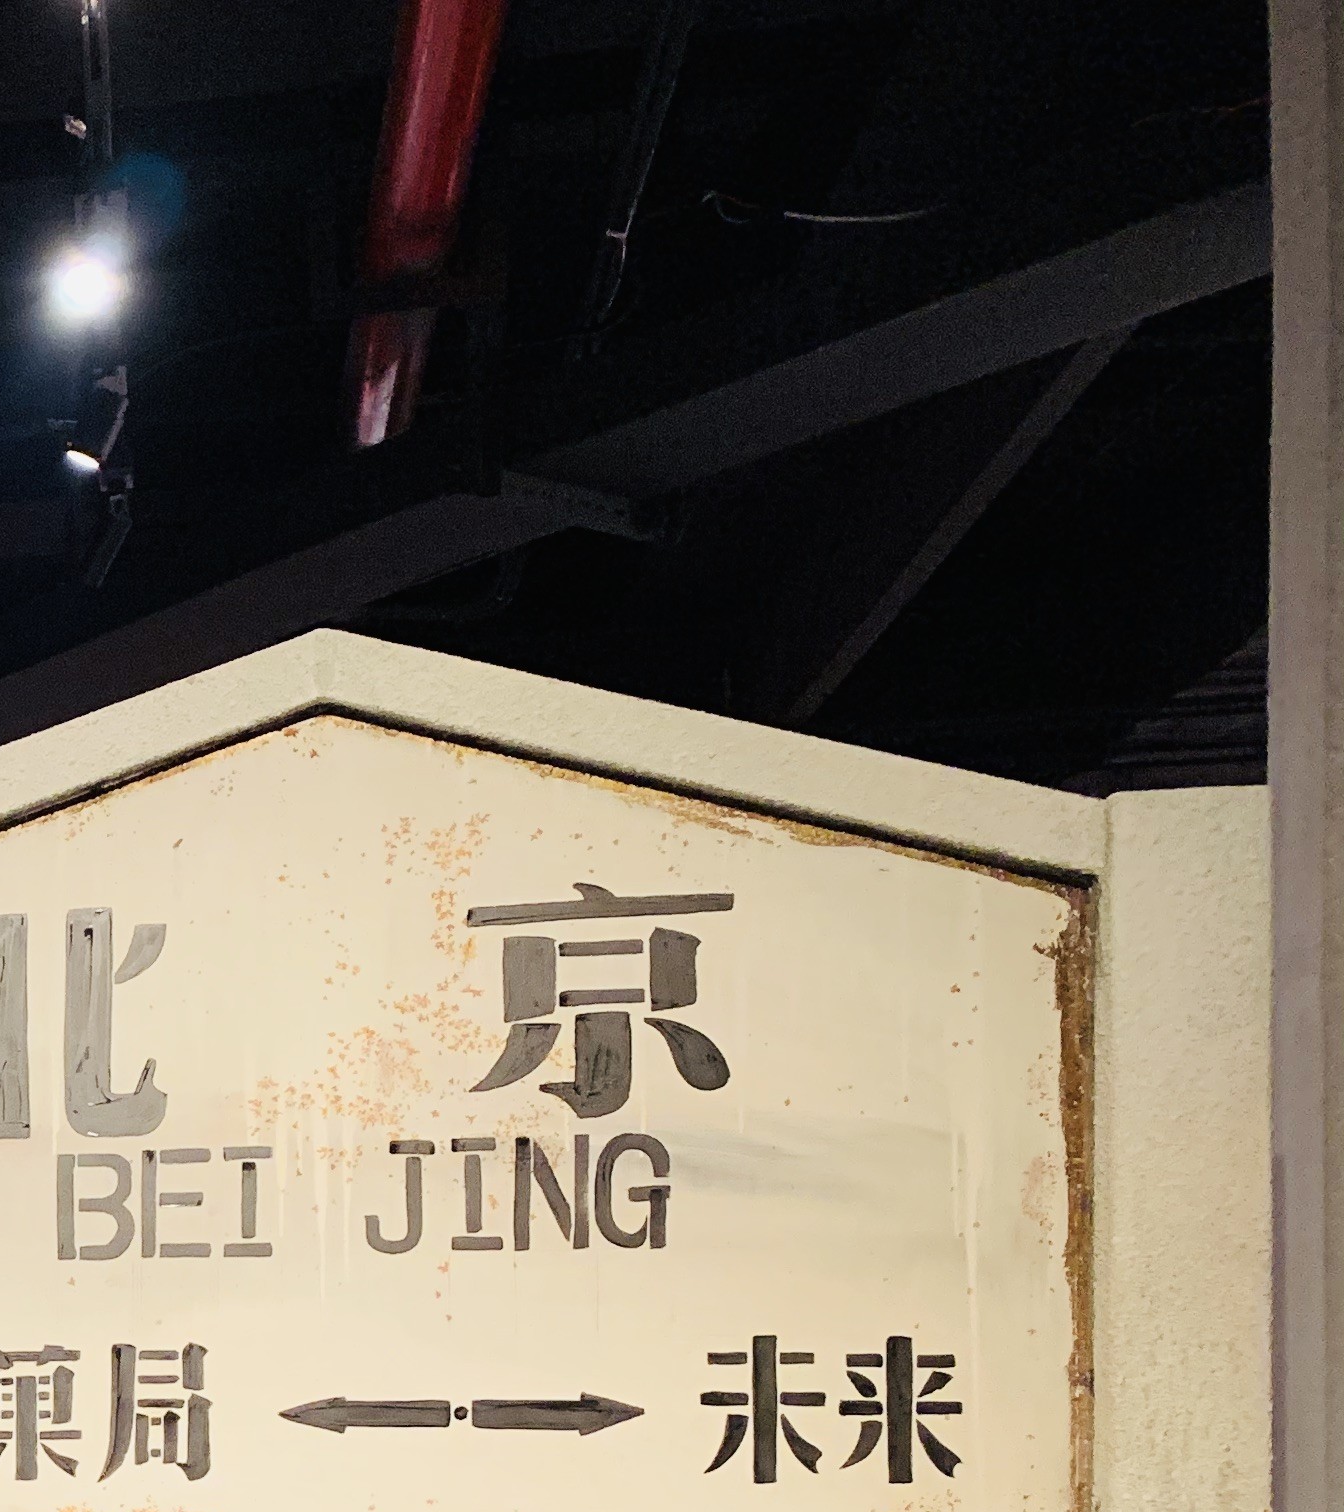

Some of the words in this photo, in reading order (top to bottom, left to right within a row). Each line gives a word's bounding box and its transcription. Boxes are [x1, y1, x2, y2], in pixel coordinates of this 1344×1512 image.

[56, 1145, 274, 1262] BEI
[363, 1132, 672, 1256] JING
[699, 1334, 964, 1485] 未来
